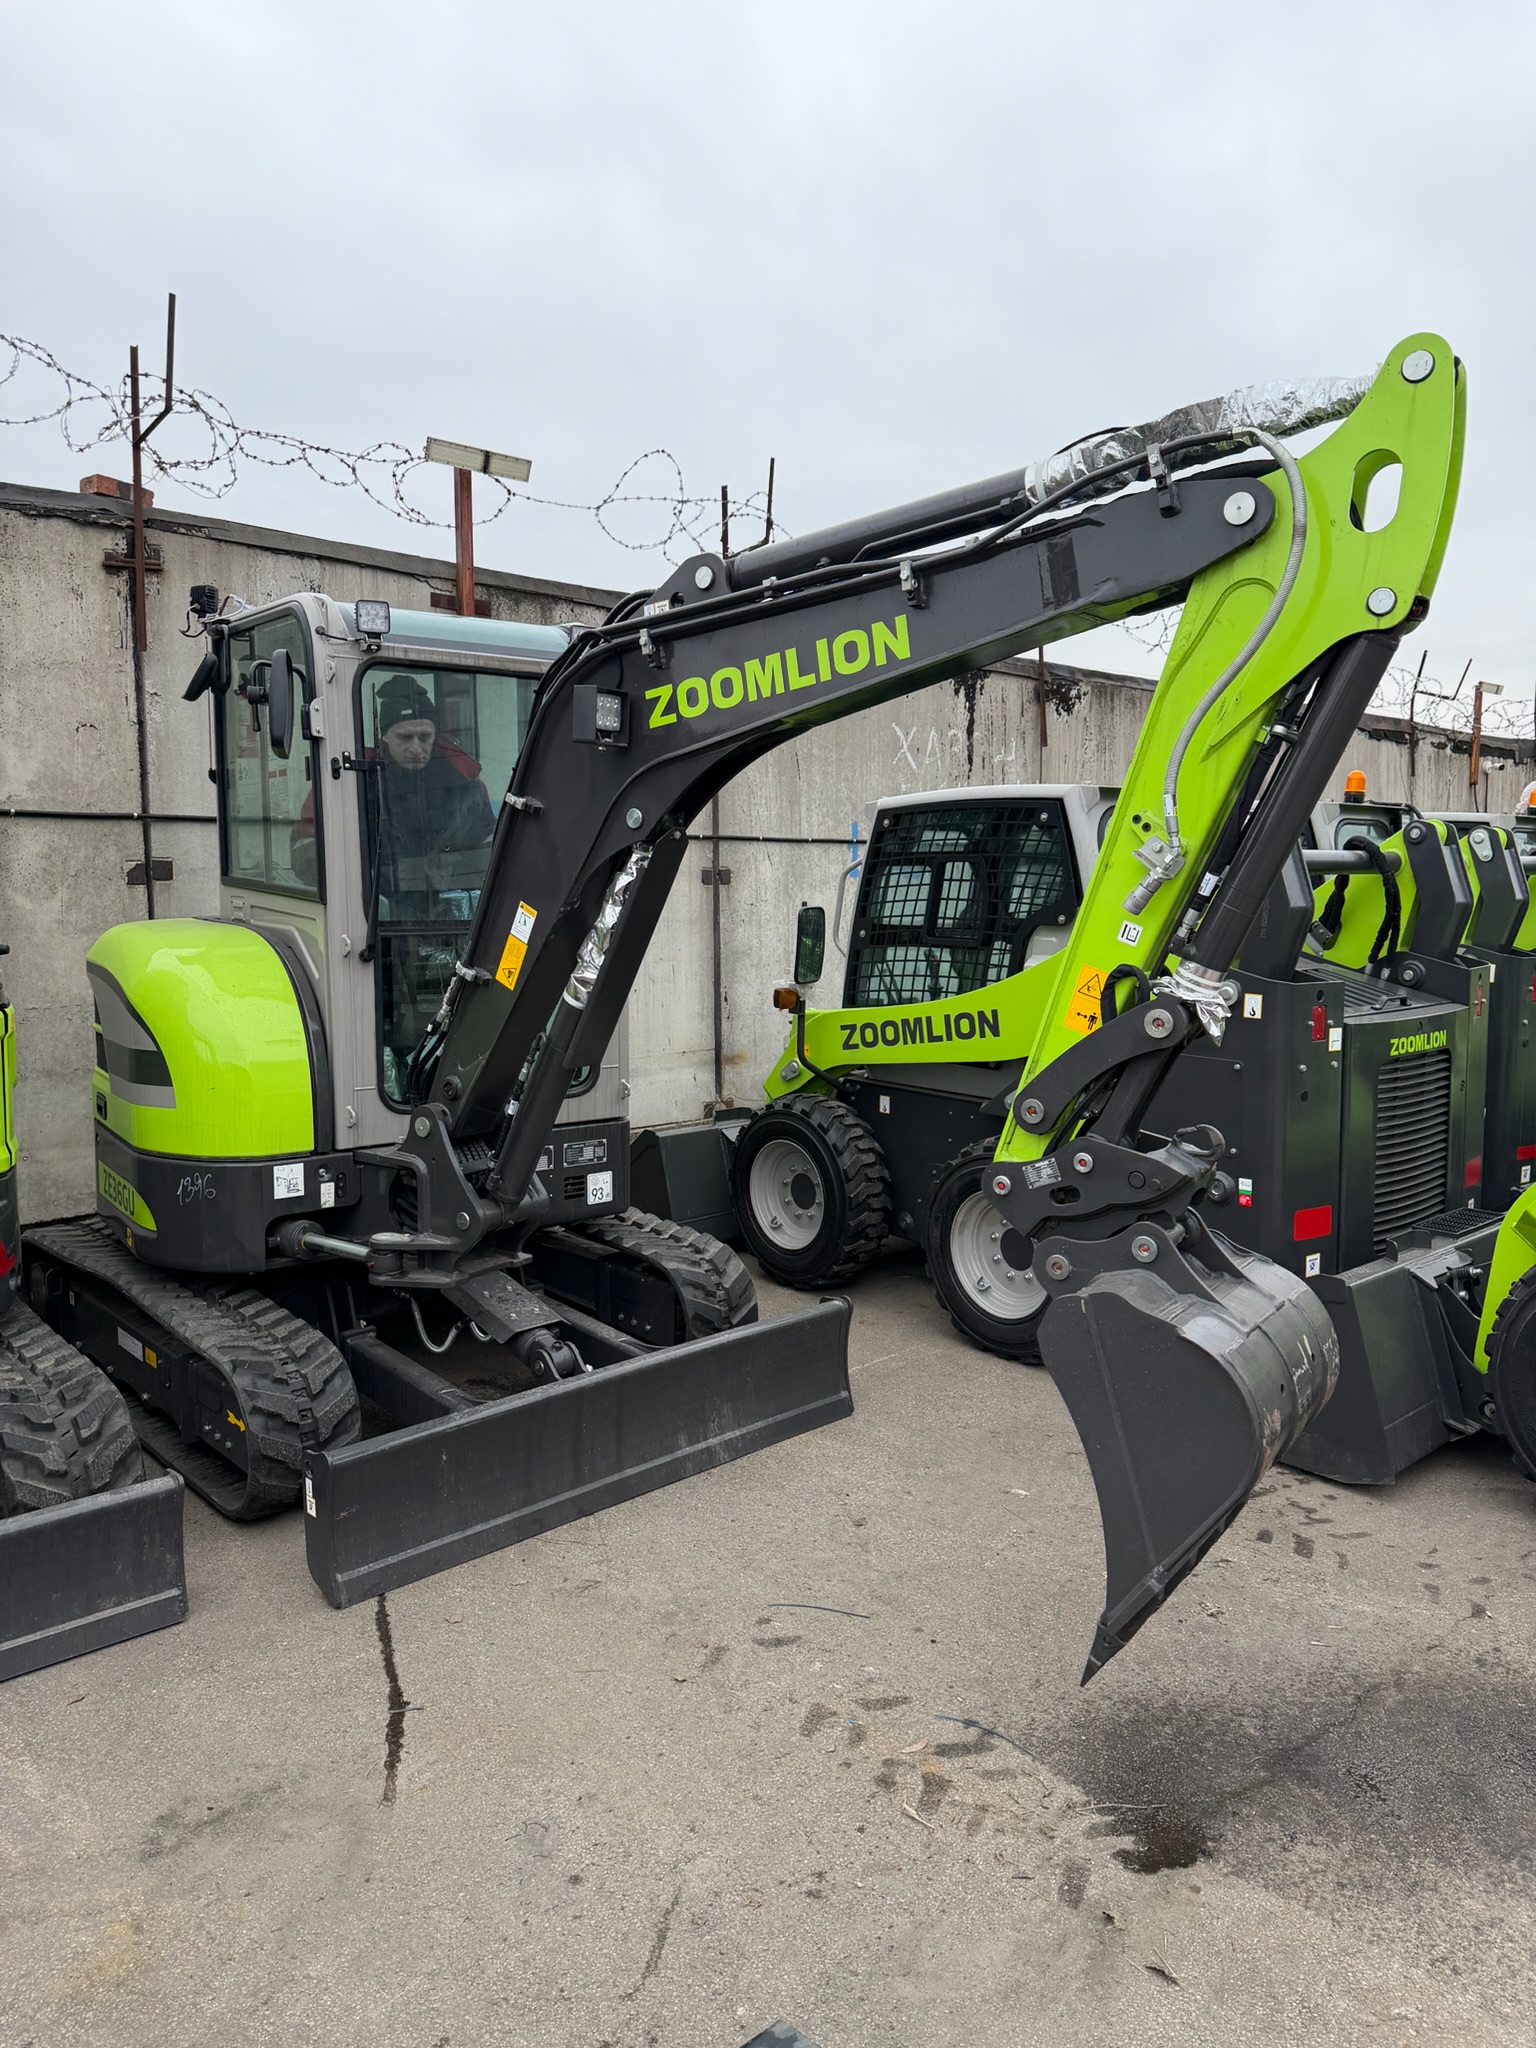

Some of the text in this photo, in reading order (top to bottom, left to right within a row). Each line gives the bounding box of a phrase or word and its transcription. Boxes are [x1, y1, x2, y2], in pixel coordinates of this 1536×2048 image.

[644, 614, 911, 729] ZOOMLION
[840, 1008, 1001, 1051] ZOOMLION
[1389, 1029, 1447, 1057] ZOOMLION
[102, 1167, 136, 1217] ZE36GU
[176, 1172, 217, 1207] 1396
[591, 1187, 605, 1202] 93
